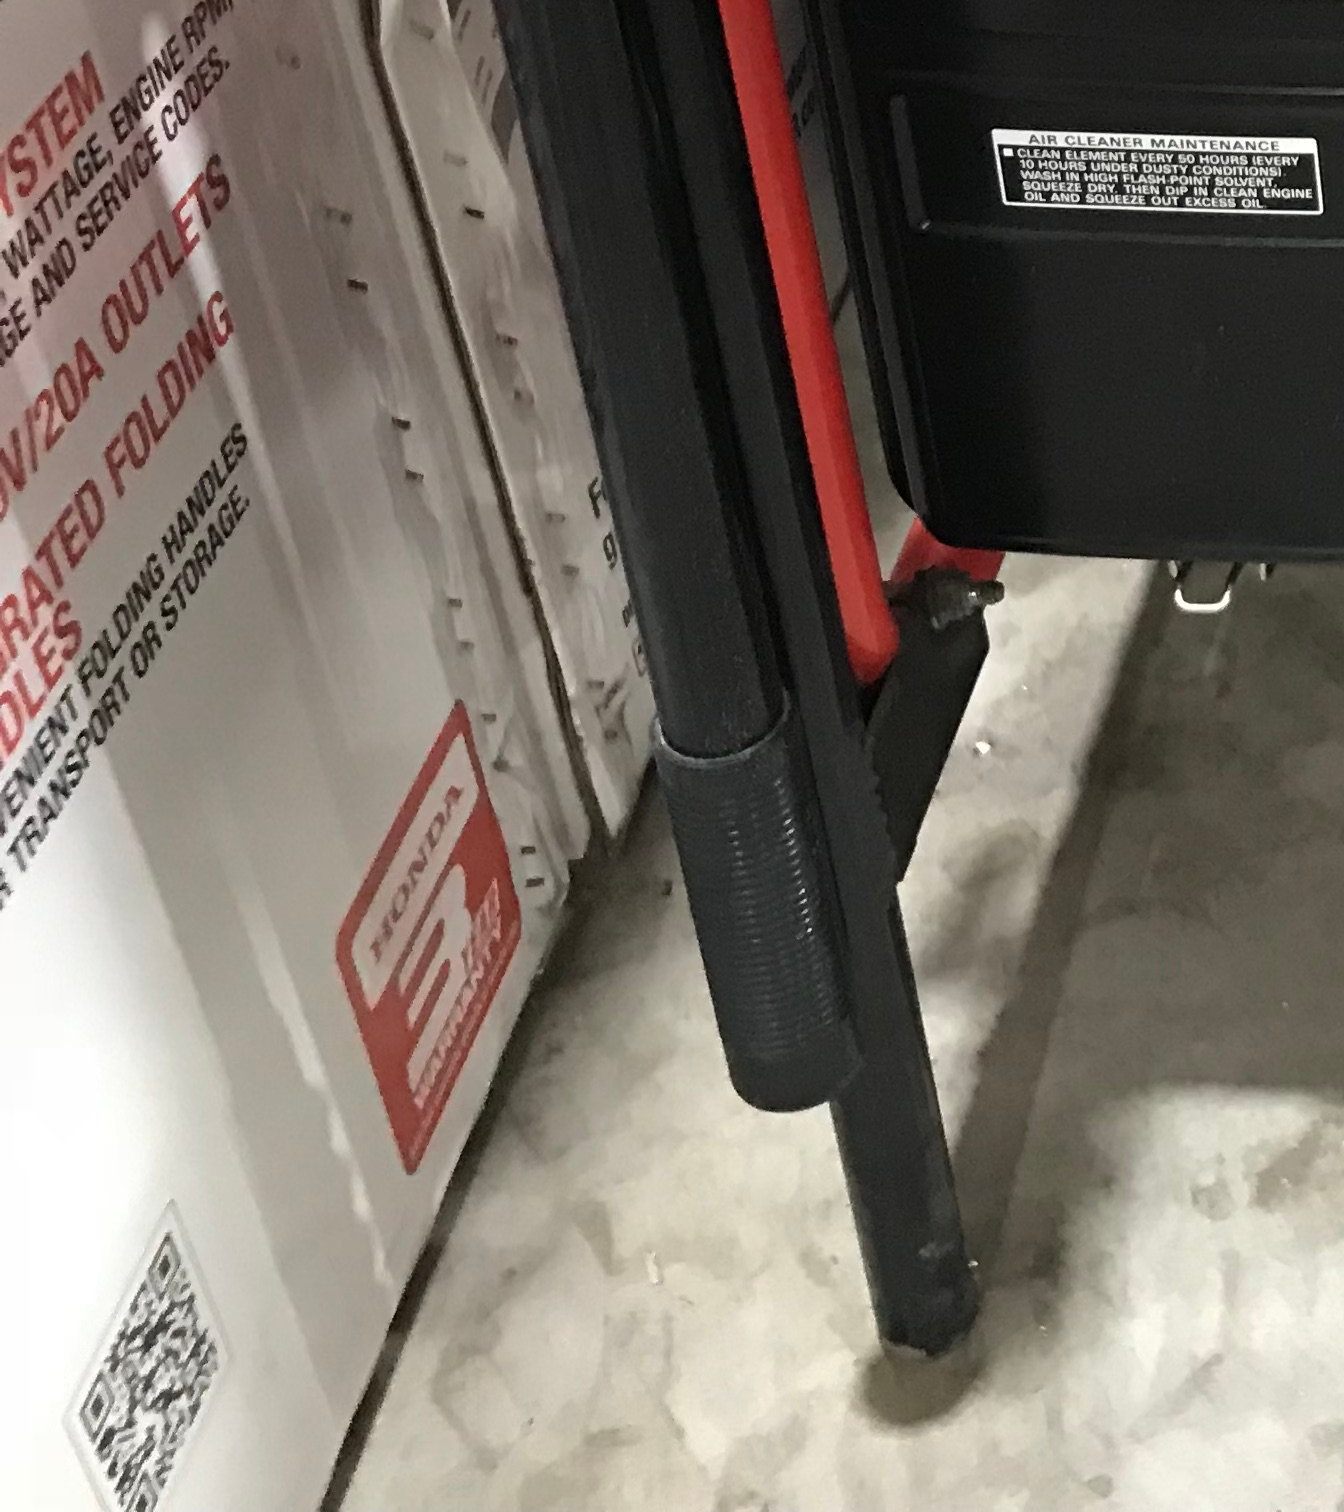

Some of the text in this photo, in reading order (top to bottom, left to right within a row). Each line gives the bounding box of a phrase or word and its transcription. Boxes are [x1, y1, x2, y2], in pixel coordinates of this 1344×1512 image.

[0, 44, 230, 368] GE AND SERVICE CODES.
[1, 131, 114, 279] WATTAGE,
[108, 33, 186, 145] ENGINE
[1016, 147, 1061, 160] CLEAN
[1065, 149, 1127, 162] ELEMENT
[1130, 152, 1175, 163] EVERY
[1199, 154, 1249, 165] HOURS
[1019, 159, 1035, 170] 10
[1038, 160, 1087, 172] HOURS
[1090, 161, 1139, 174] UNDER
[1142, 163, 1188, 175] DUSTY
[1019, 169, 1062, 182] WASH
[1065, 171, 1080, 182] IN
[1083, 172, 1119, 184] HIGH
[1022, 180, 1083, 193] SQUEEZE
[1122, 184, 1160, 196] THEN
[1165, 185, 1189, 196] DIP
[1193, 186, 1208, 197] IN
[1213, 187, 1258, 199] CLEAN
[1263, 188, 1313, 200] ENGINE
[1024, 191, 1046, 202] OIL
[1050, 192, 1081, 203] AND
[1085, 193, 1147, 205] SQUEEZE
[1150, 195, 1180, 206] OUT
[1184, 196, 1237, 208] EXCESS
[1028, 133, 1281, 153] AIR CLEANER MAINTENANCE
[0, 152, 233, 524] V/20A OUTLETS
[103, 289, 235, 499] FOLDING
[76, 551, 166, 699] FOLDING
[161, 421, 249, 567] HANDLES
[0, 599, 83, 758] DLES
[7, 484, 251, 872] TRANSPORT OR STORAGE.
[369, 784, 465, 966] HONDA
